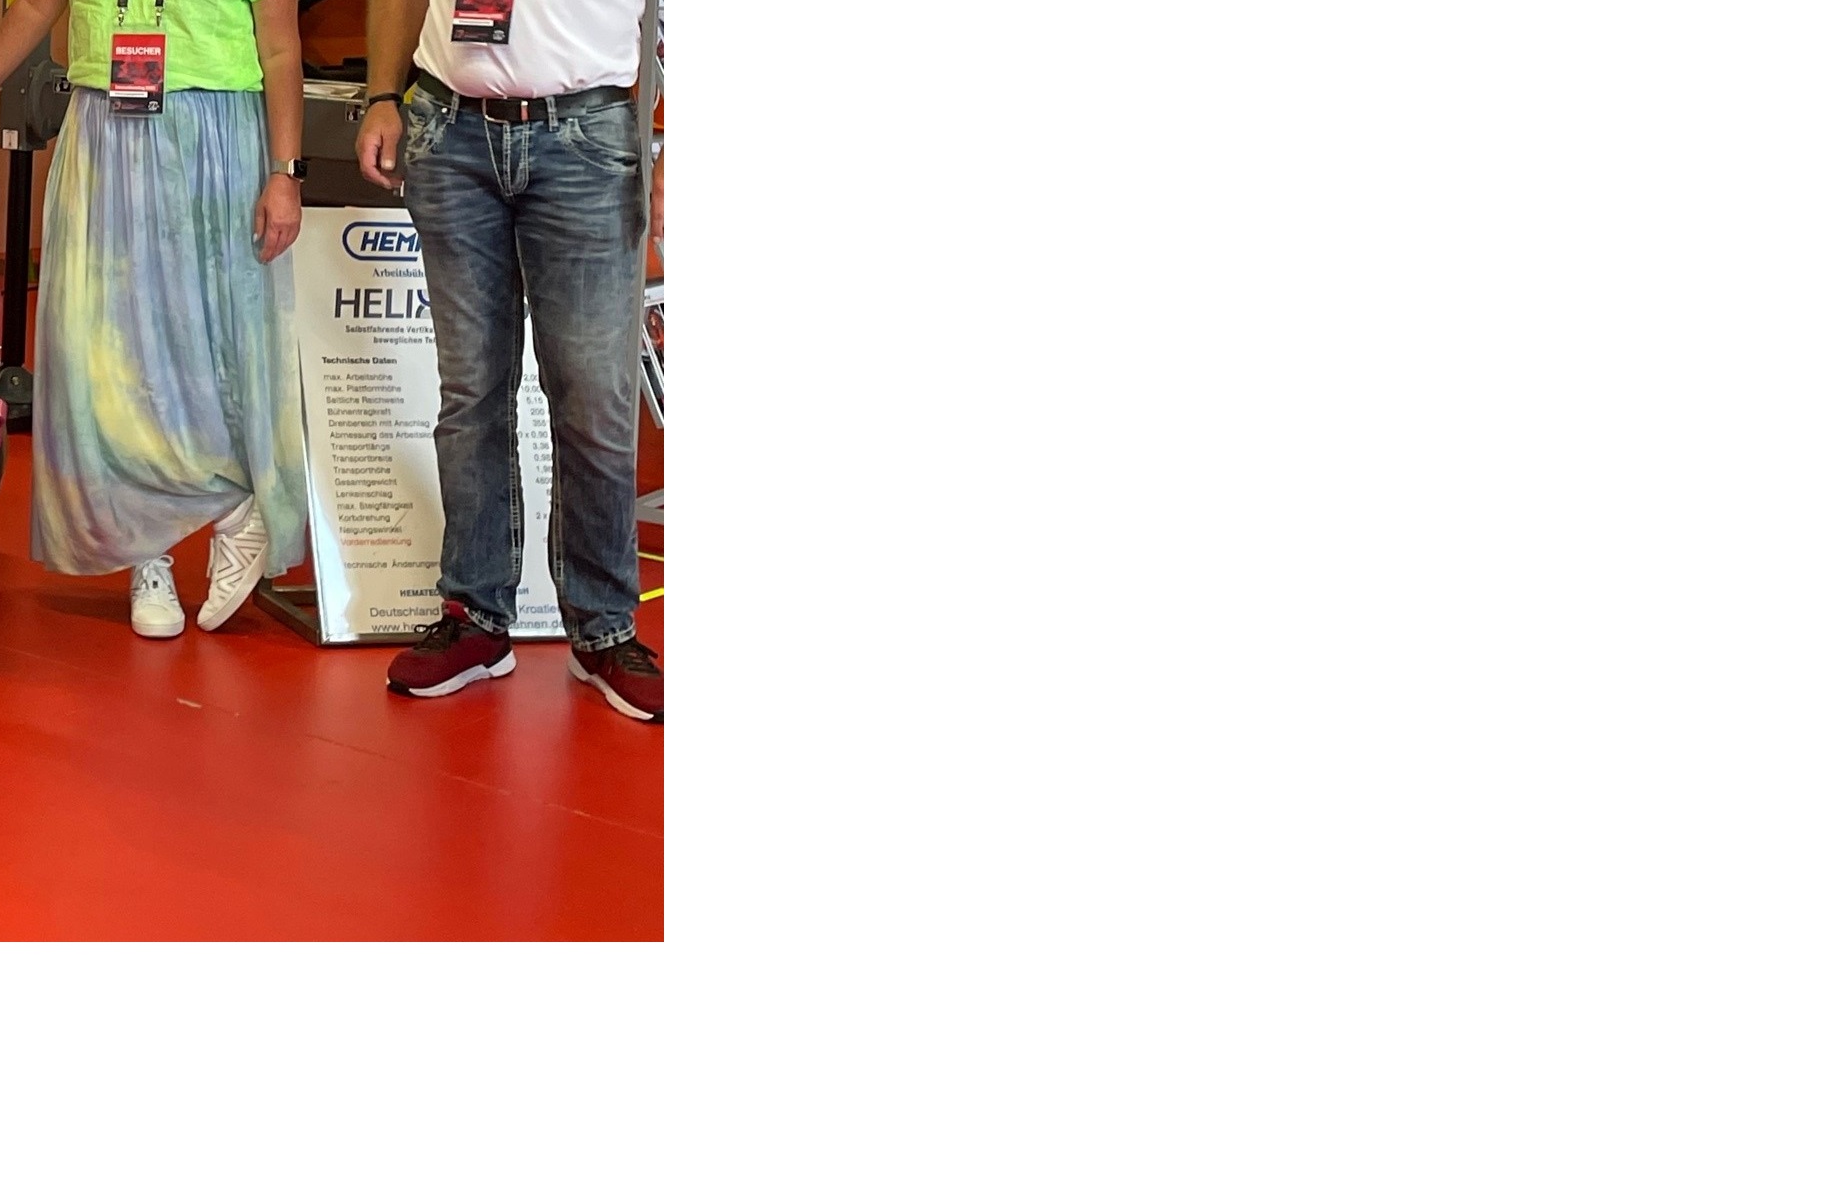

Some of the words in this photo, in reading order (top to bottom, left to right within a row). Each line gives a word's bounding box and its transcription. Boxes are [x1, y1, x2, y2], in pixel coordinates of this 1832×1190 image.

[115, 46, 162, 56] BESUCHER
[373, 268, 425, 278] Arbeitsbüh
[345, 325, 405, 333] Selbstfahrende
[406, 325, 434, 333] Vertika
[373, 337, 423, 345] beweglichen
[322, 356, 370, 364] Technische
[346, 373, 393, 381] Arbeitshöhe
[346, 385, 402, 393] Plattformhöhe
[326, 396, 360, 404] Seitliche
[362, 396, 405, 404] Reichweite
[327, 408, 391, 416] Bühnentragkraft
[394, 420, 430, 428] Anschlag
[330, 431, 377, 440] Abmessung
[379, 431, 394, 439] des
[331, 443, 390, 451] Transportlänge
[332, 454, 393, 463] Transportbreite
[333, 466, 391, 475] Transporthöhe
[334, 478, 397, 487] Gesamtgewicht
[336, 491, 393, 499] Lenkeinschlag
[359, 502, 414, 511] Steigfähigkeit
[338, 514, 391, 523] Korbdrehung
[339, 526, 402, 535] Neigungswinkel
[369, 606, 440, 618] Deutschland
